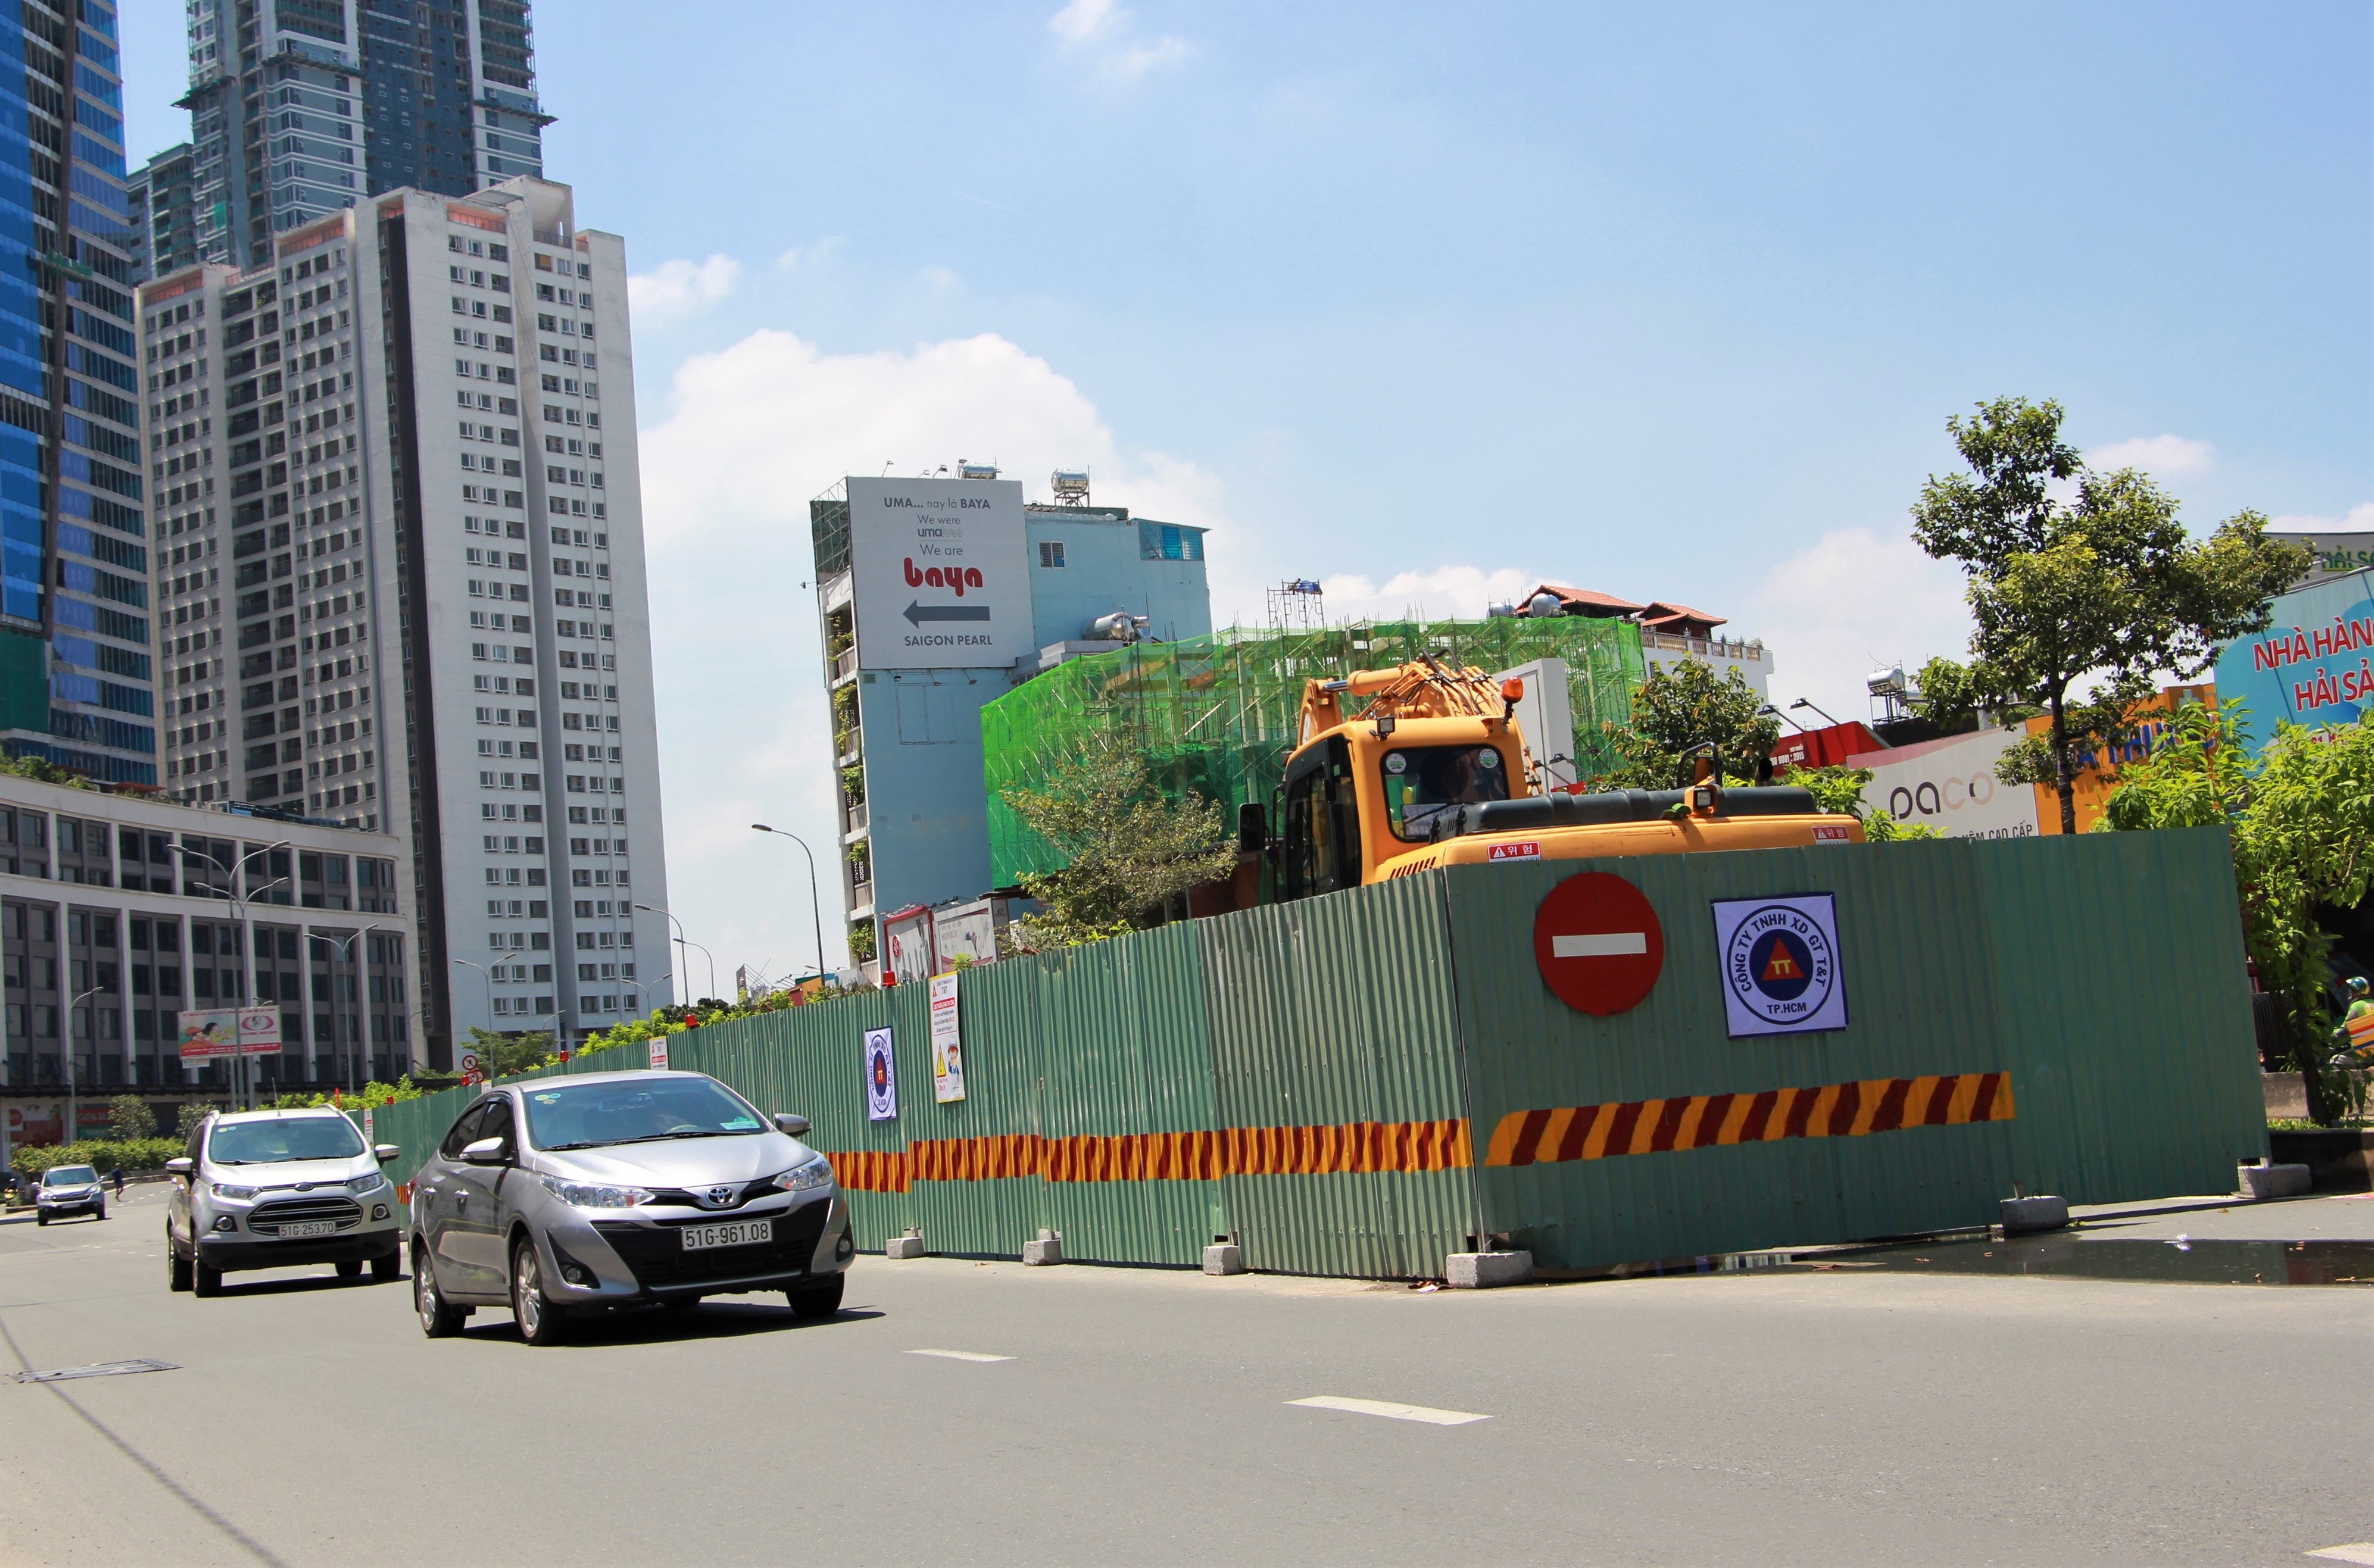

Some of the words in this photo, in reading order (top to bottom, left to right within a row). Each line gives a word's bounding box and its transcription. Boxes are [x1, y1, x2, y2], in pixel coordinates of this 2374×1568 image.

[884, 497, 924, 507] UMA...
[927, 500, 945, 510] nay
[948, 497, 957, 509] là
[960, 499, 991, 509] BAYA
[917, 514, 935, 524] We
[938, 516, 961, 524] were
[920, 544, 941, 555] We
[945, 547, 964, 555] are
[903, 557, 984, 597] baya
[904, 635, 954, 646] SAIGON
[957, 635, 993, 646] PEARL
[2253, 627, 2312, 671] NHÀ
[2312, 616, 2374, 658] HÀN
[2294, 669, 2340, 711] HẢI
[1793, 751, 1805, 761] 2015
[1889, 771, 1994, 822] paco
[1751, 913, 1787, 932] TNHH
[1790, 916, 1809, 934] XD
[1738, 930, 1753, 949] TY
[1808, 934, 1824, 952] GT
[1735, 953, 1752, 992] CÔNG
[1771, 959, 1791, 974] TT
[1815, 957, 1827, 987] T&T
[1766, 1002, 1807, 1014] TP.HCM
[281, 1222, 334, 1237] 51G-253.70
[686, 1222, 769, 1247] 51G-961.08
